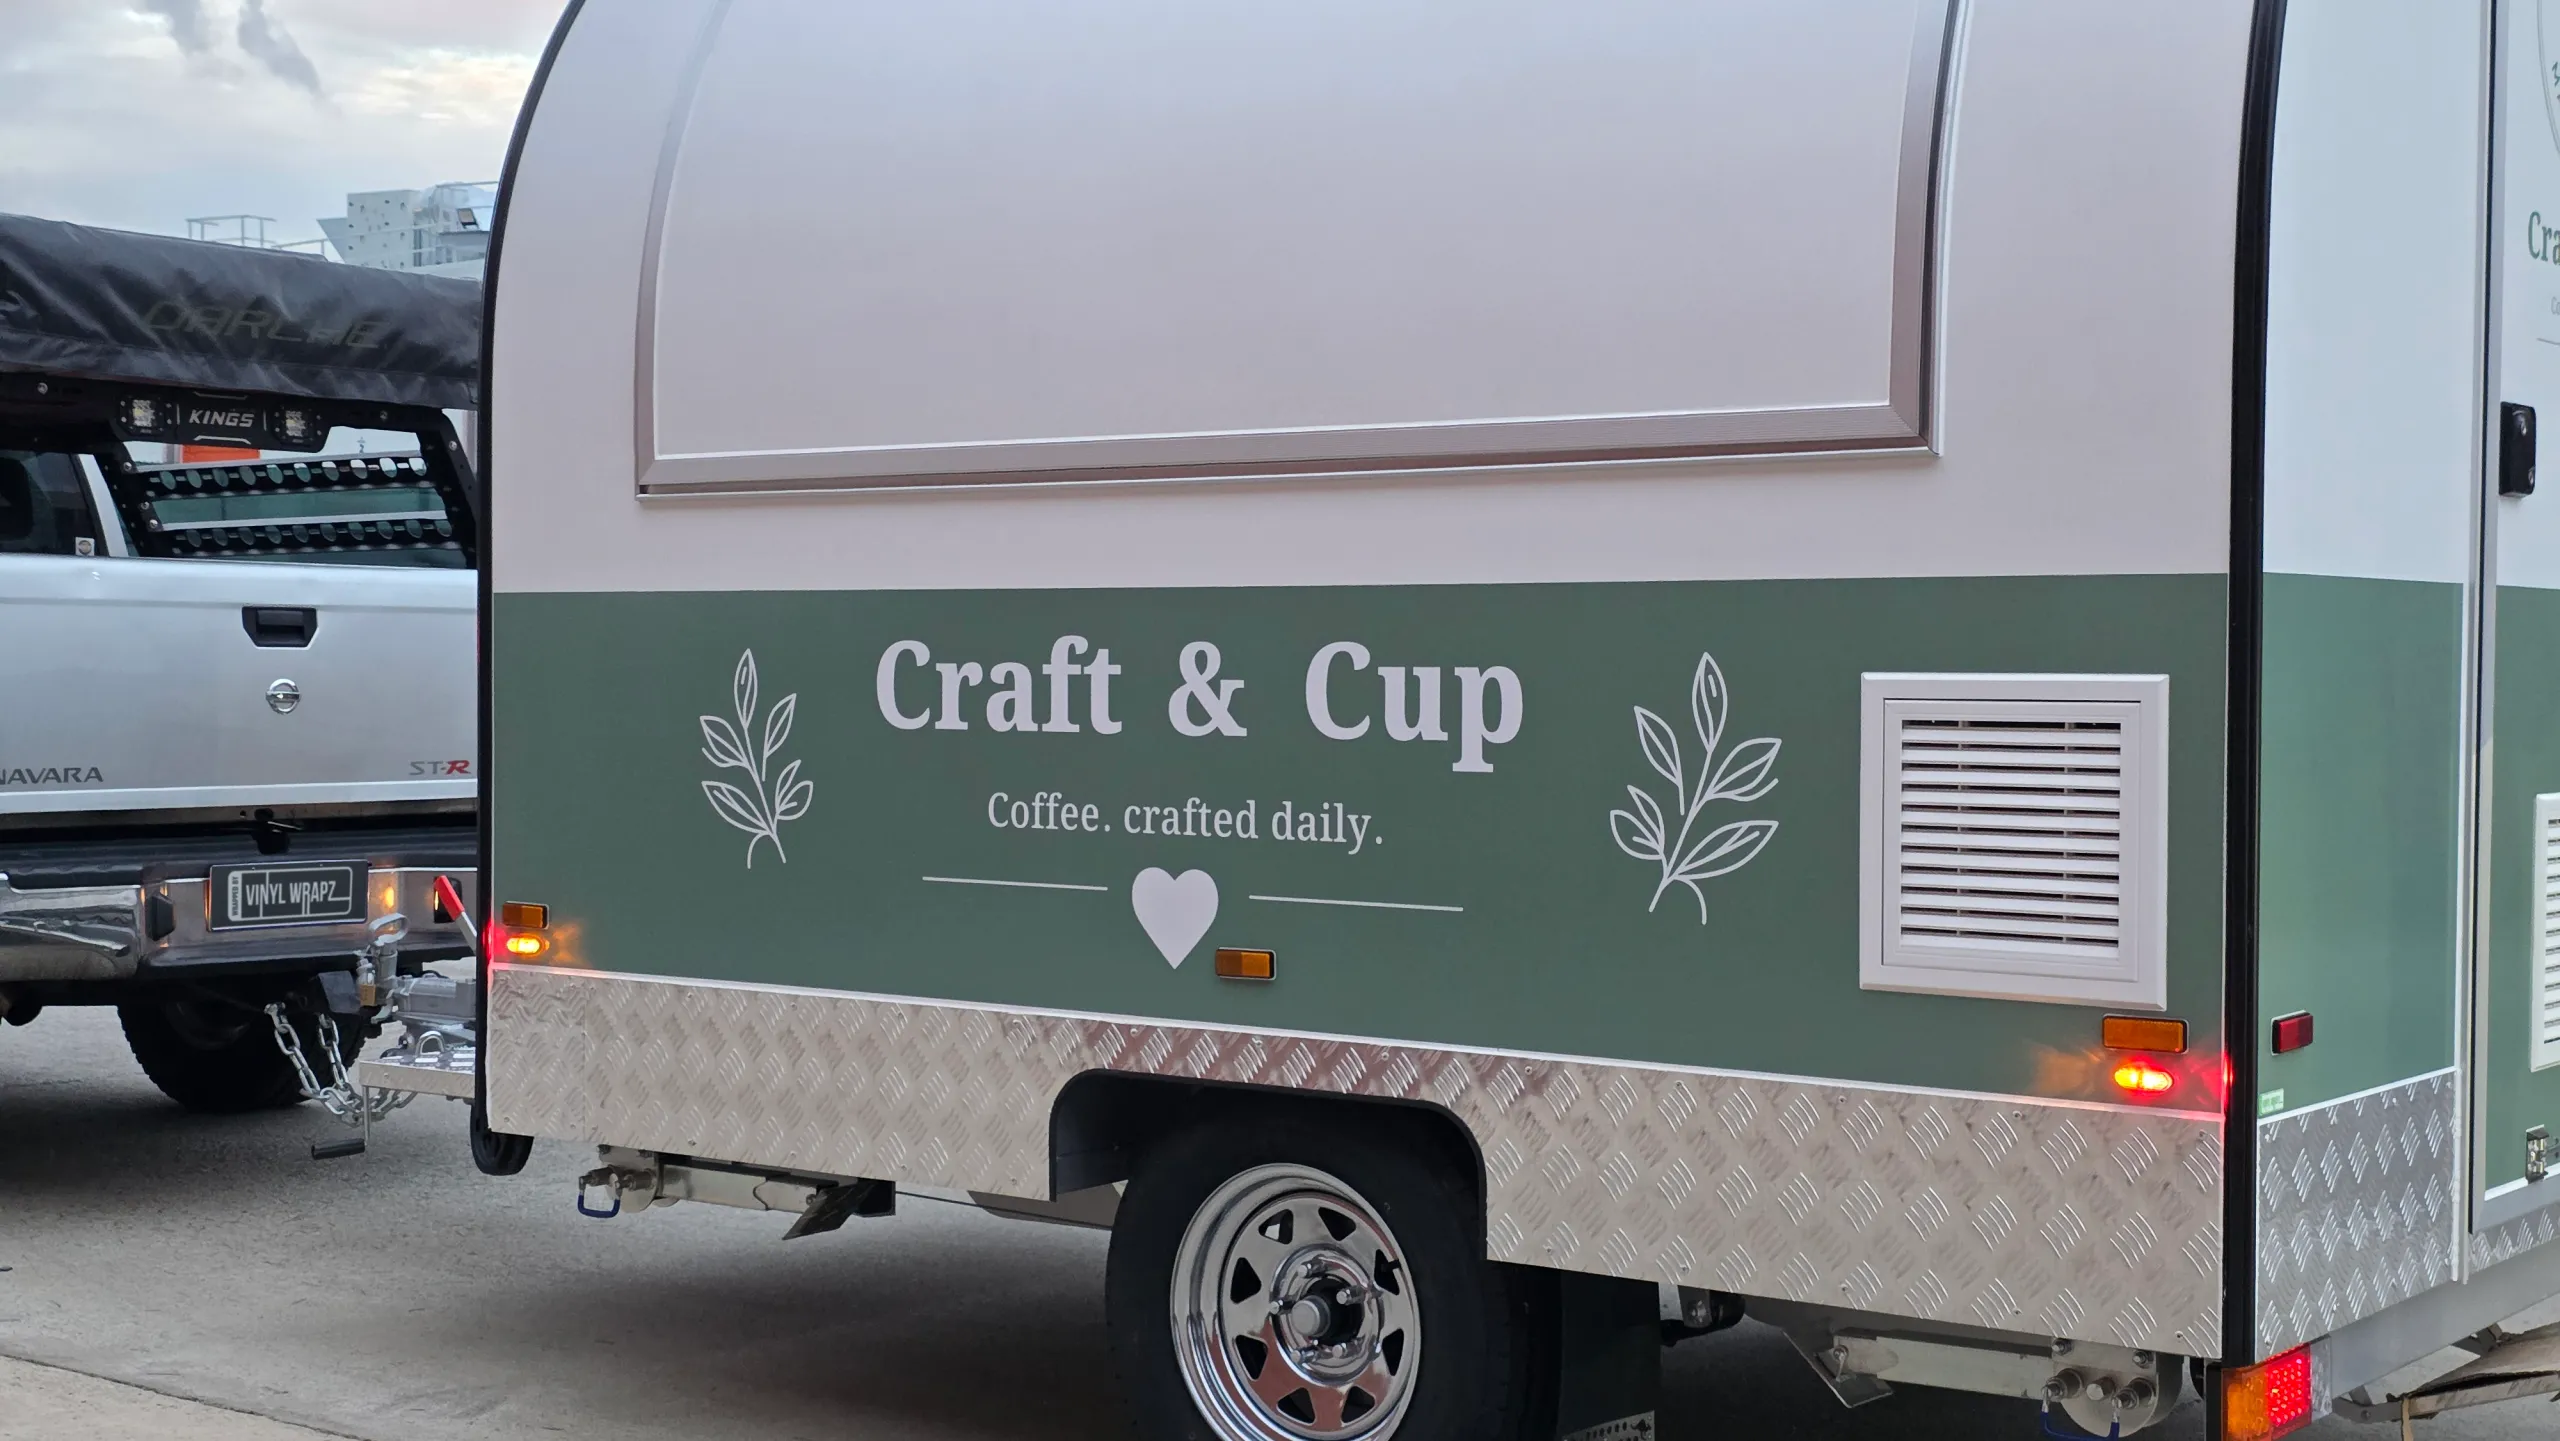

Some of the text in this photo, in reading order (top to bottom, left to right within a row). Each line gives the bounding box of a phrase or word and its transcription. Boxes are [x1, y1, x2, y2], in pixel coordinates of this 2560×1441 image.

[189, 409, 254, 428] KINGS
[876, 634, 1524, 773] Craft & Cup
[409, 760, 472, 776] ST-R
[988, 791, 1384, 855] Coffee. crafted daily.
[231, 876, 239, 917] WRAPPED BY
[246, 880, 337, 906] VINYL WRAPZ
